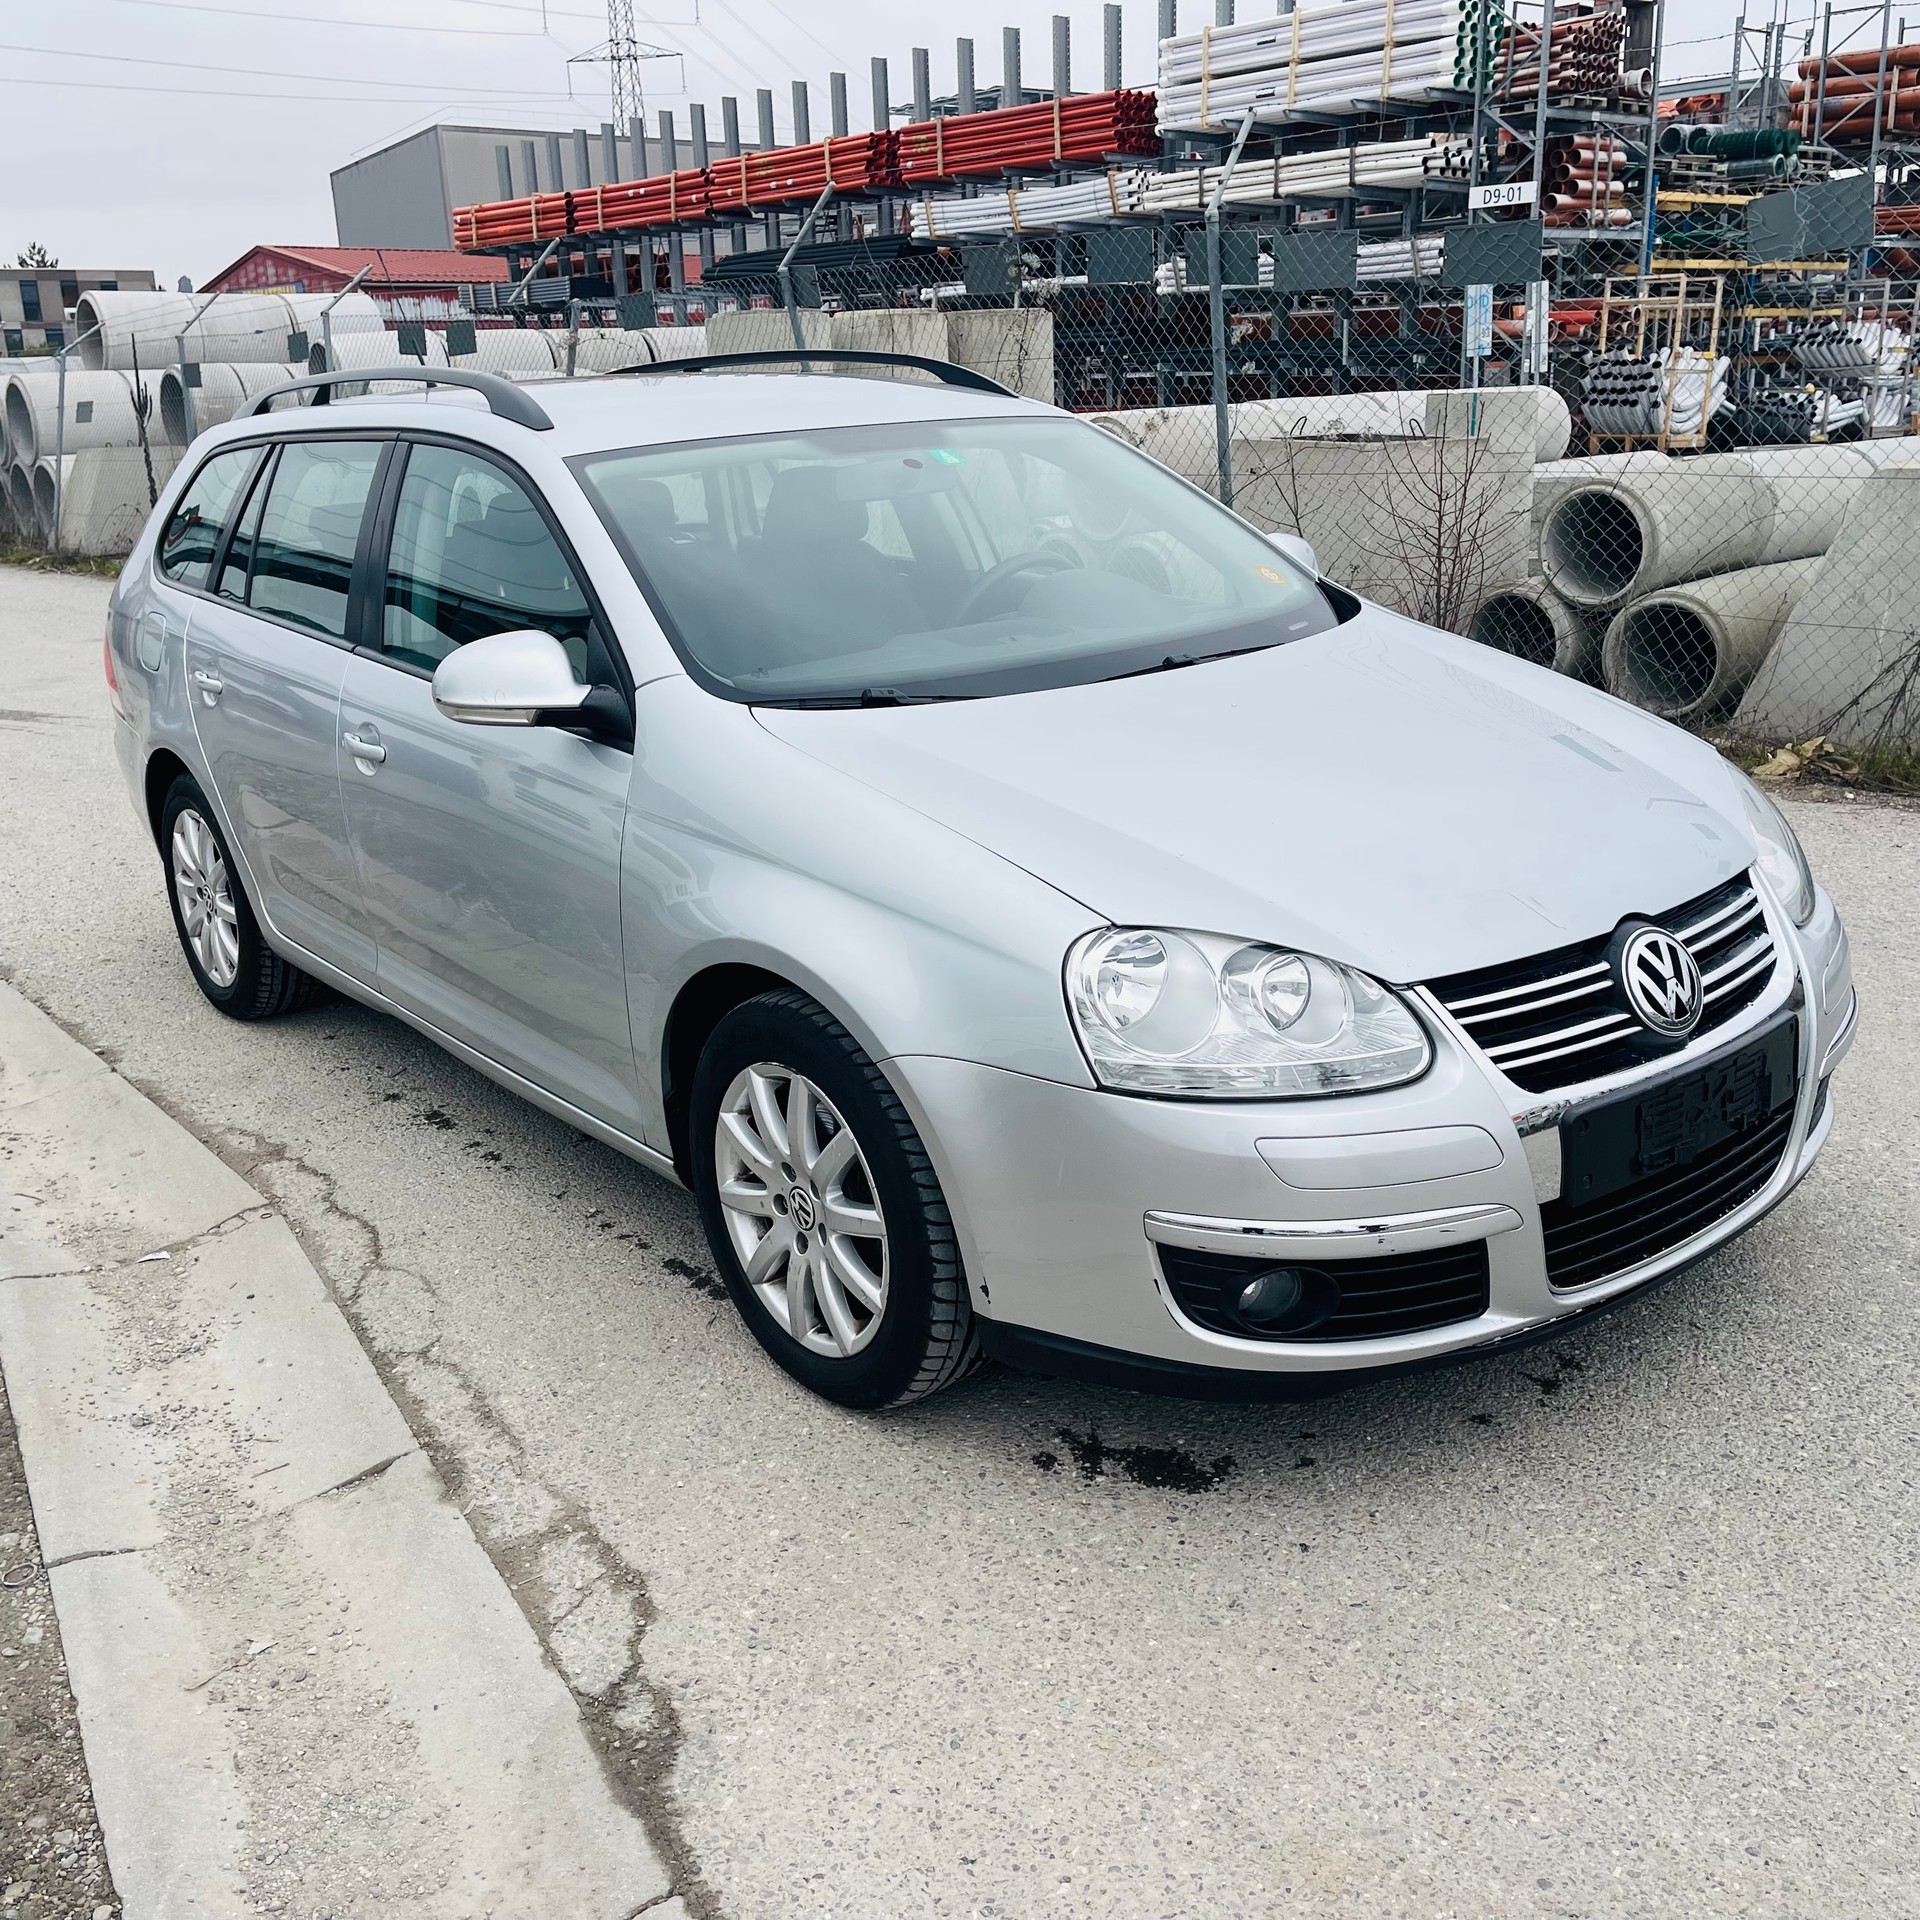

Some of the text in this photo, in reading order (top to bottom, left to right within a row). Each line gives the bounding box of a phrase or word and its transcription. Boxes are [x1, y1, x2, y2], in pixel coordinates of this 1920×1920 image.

[1483, 187, 1522, 204] D9-01
[1623, 928, 1703, 1033] VW
[790, 1188, 814, 1230] VW
